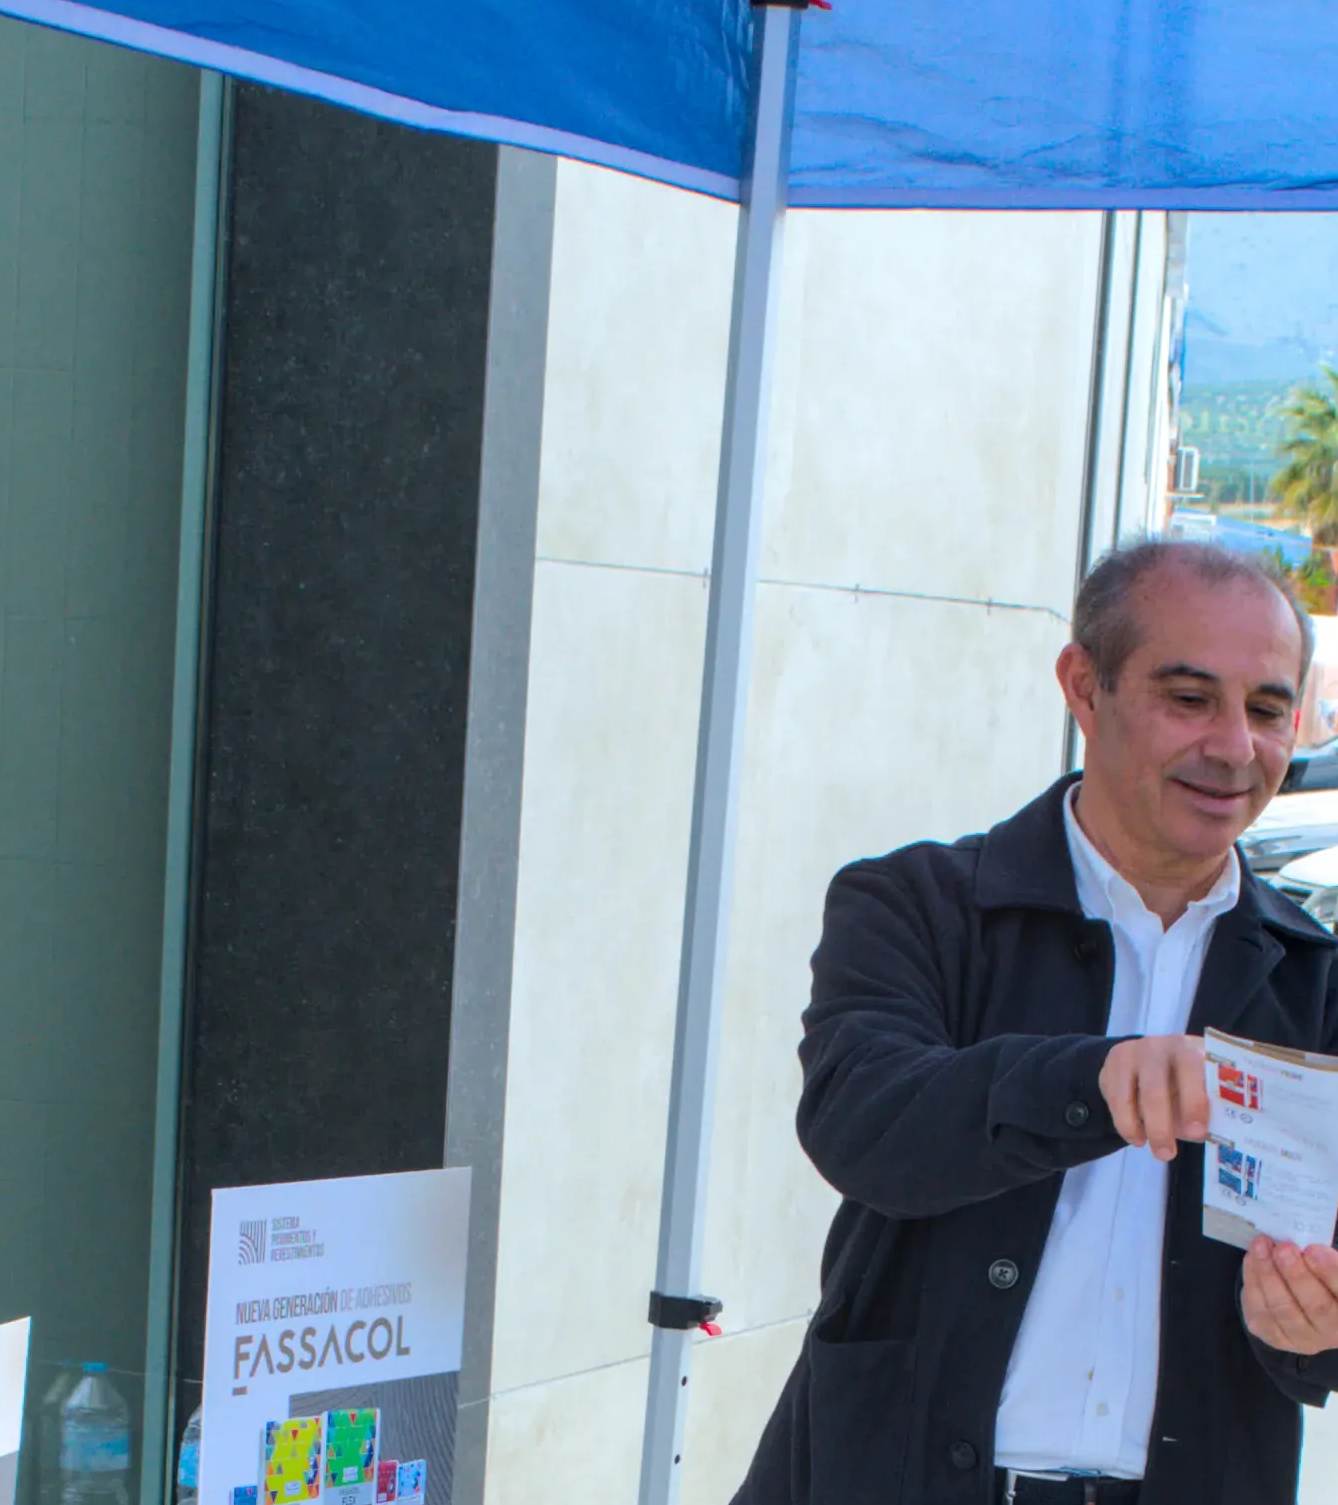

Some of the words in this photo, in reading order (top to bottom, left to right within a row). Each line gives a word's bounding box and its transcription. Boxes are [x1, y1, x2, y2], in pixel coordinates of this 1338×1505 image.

[235, 1298, 271, 1325] NUEVA
[273, 1286, 338, 1320] GENERACIÓN
[340, 1289, 352, 1312] DE
[355, 1282, 412, 1310] ADHESIVOS
[233, 1315, 411, 1380] FASSACOL
